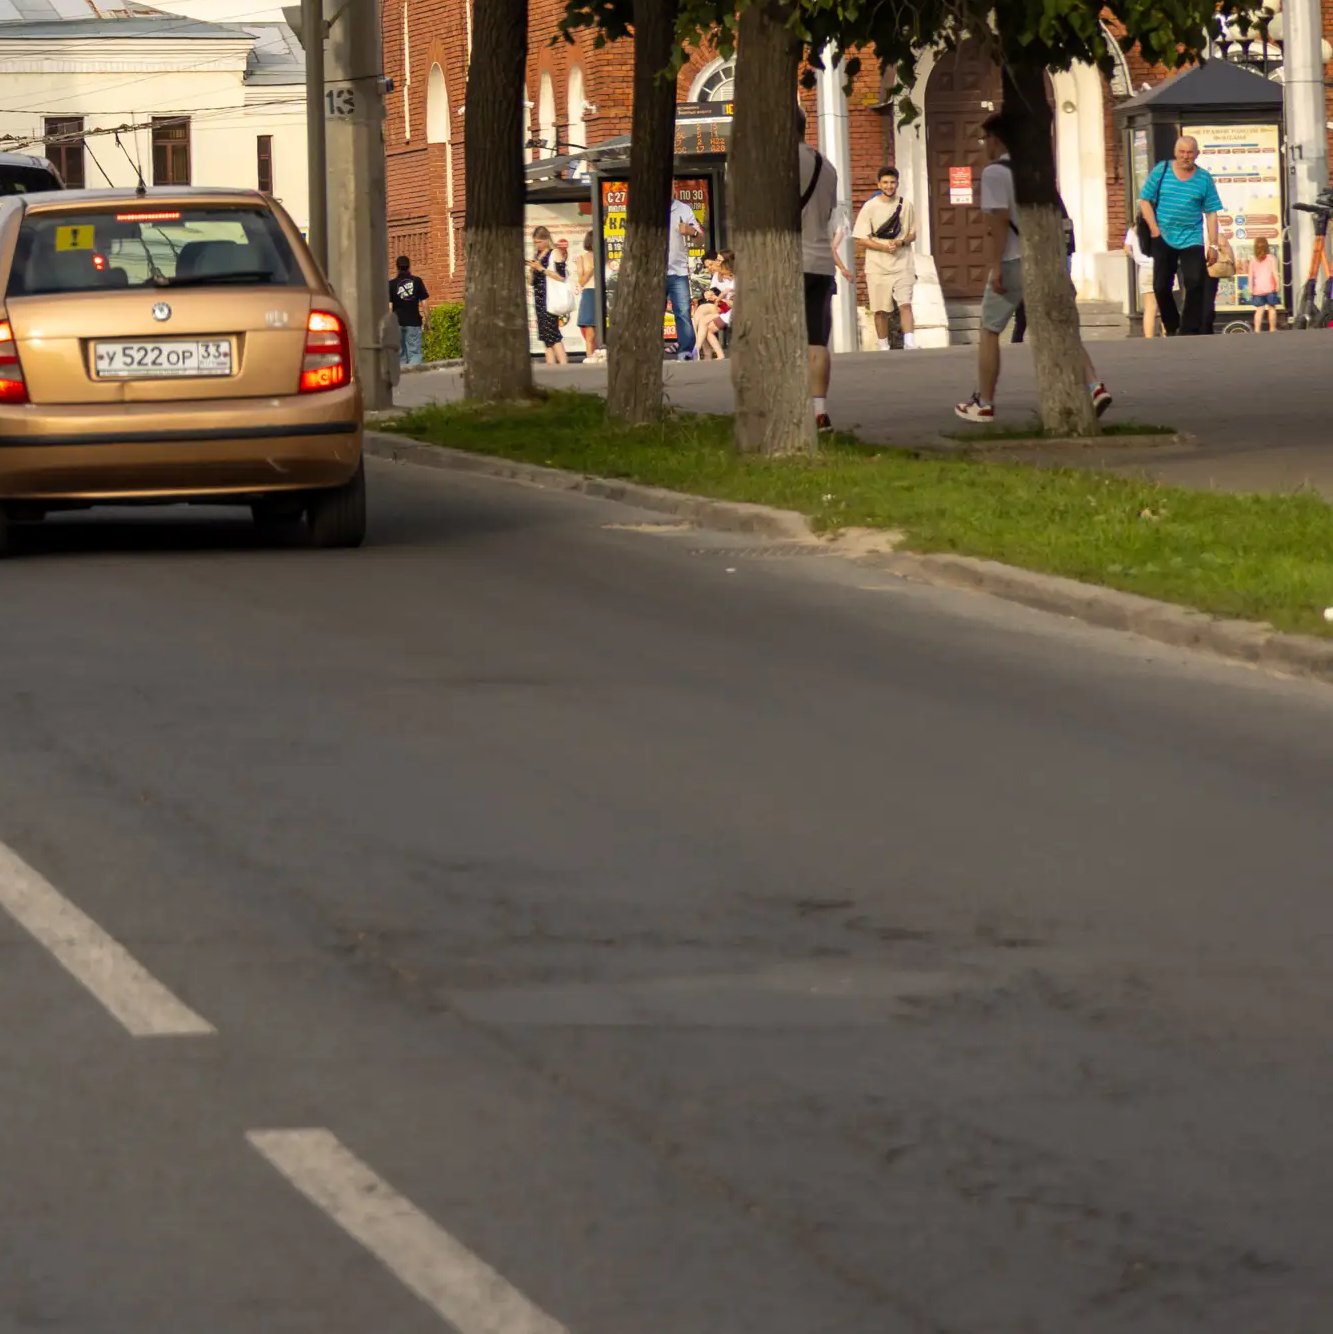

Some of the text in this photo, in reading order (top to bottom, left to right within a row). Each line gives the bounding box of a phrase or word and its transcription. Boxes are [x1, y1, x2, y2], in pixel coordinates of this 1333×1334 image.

[325, 89, 355, 115] 13
[607, 192, 626, 203] С 27
[680, 190, 703, 200] ПО 30
[105, 344, 222, 367] У522ОР 33
